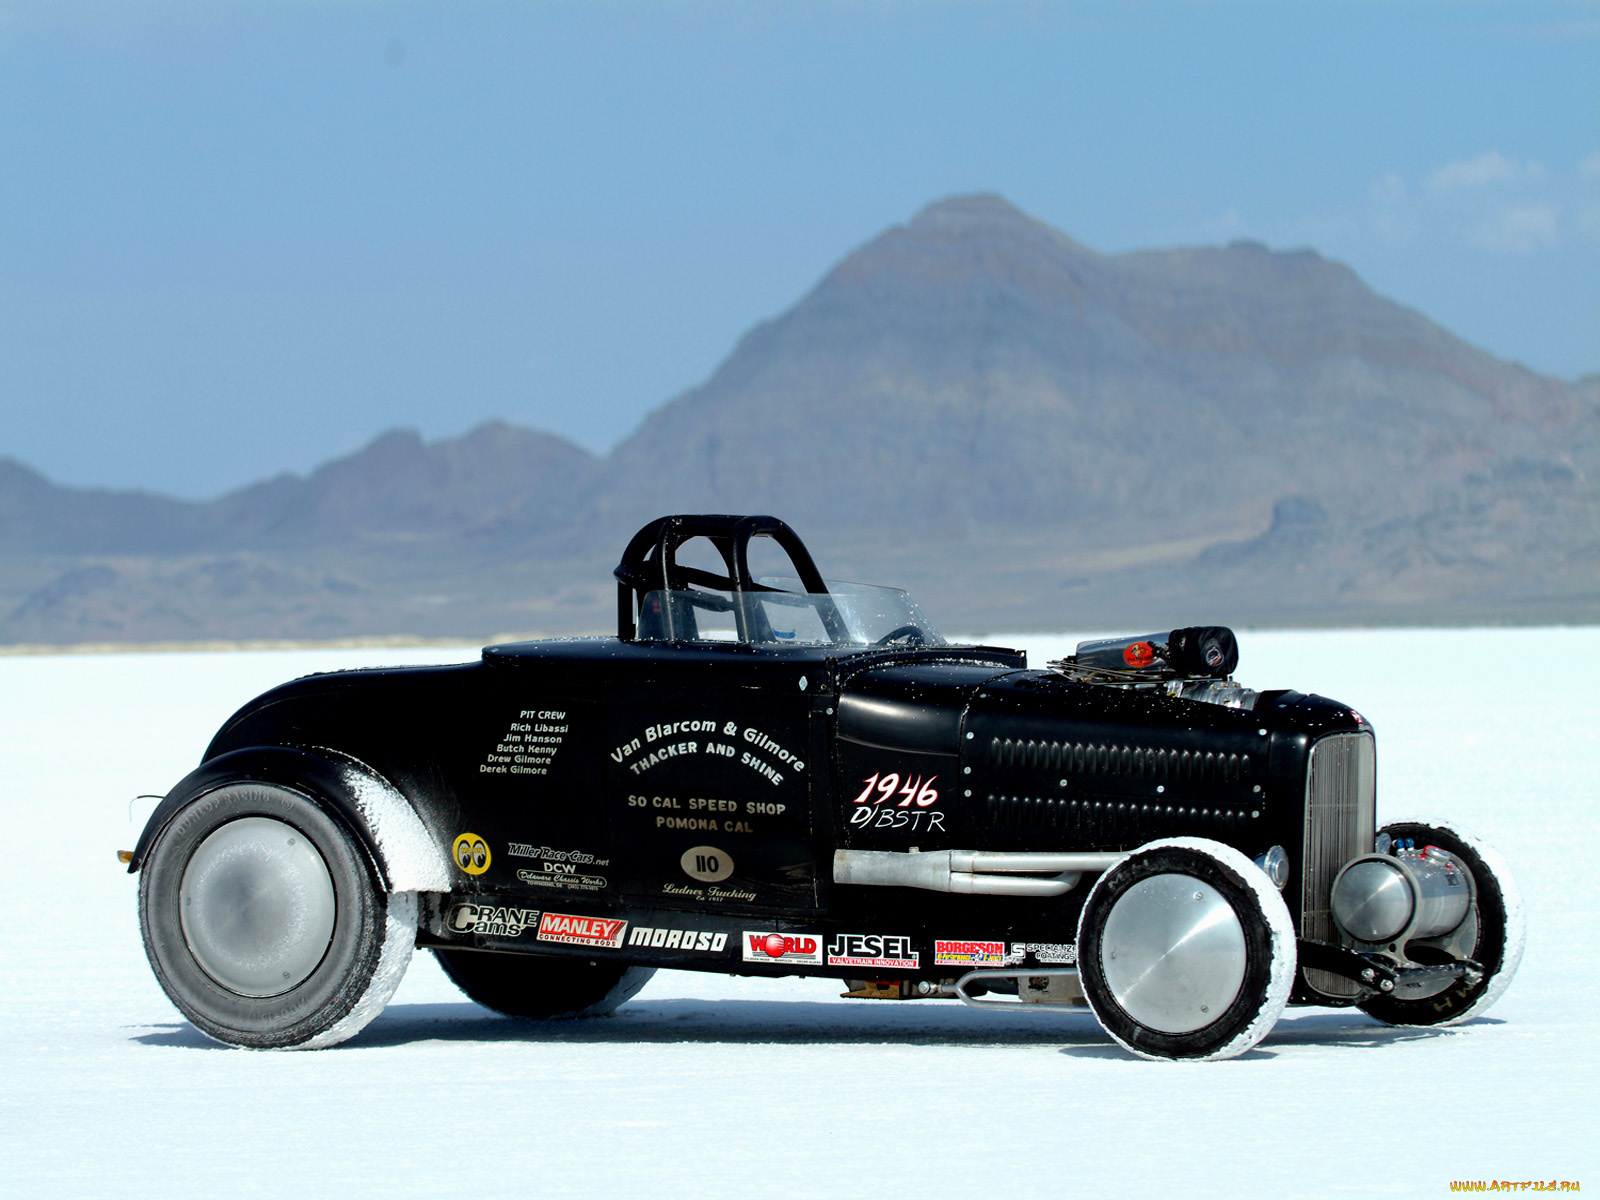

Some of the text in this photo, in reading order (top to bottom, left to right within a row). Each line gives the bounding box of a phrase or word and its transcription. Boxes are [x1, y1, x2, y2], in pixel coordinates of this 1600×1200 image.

[520, 710, 566, 720] PIT CREW
[510, 723, 569, 733] Rich Libassi
[503, 734, 562, 744] Jim Hanson
[610, 720, 805, 772] Van Blarcom & Gilmore
[496, 744, 557, 756] Butch Kenny
[487, 754, 551, 765] Drew Gilmore
[630, 741, 784, 786] THACKER AND SHINE
[479, 764, 547, 775] Derek Gilmore
[852, 771, 939, 808] 1946
[177, 789, 270, 836] DUNLOP RACING
[628, 795, 786, 815] SO CAL SPEED SHOP
[656, 816, 754, 833] POMONA CAL
[850, 804, 946, 832] D/BSTR
[507, 842, 541, 858] Miller
[540, 846, 567, 861] Race
[543, 862, 576, 874] DCW
[695, 855, 719, 873] 110
[447, 903, 540, 933] CRANE
[541, 916, 615, 938] MANLEY
[539, 933, 617, 947] CONNECTING RODS
[628, 927, 729, 952] MOROSO
[749, 933, 817, 958] WORLD
[827, 934, 914, 960] JESEL
[936, 941, 1003, 954] BORGESON
[831, 957, 873, 966] VALVETRAIN
[873, 958, 914, 968] INNOVATION
